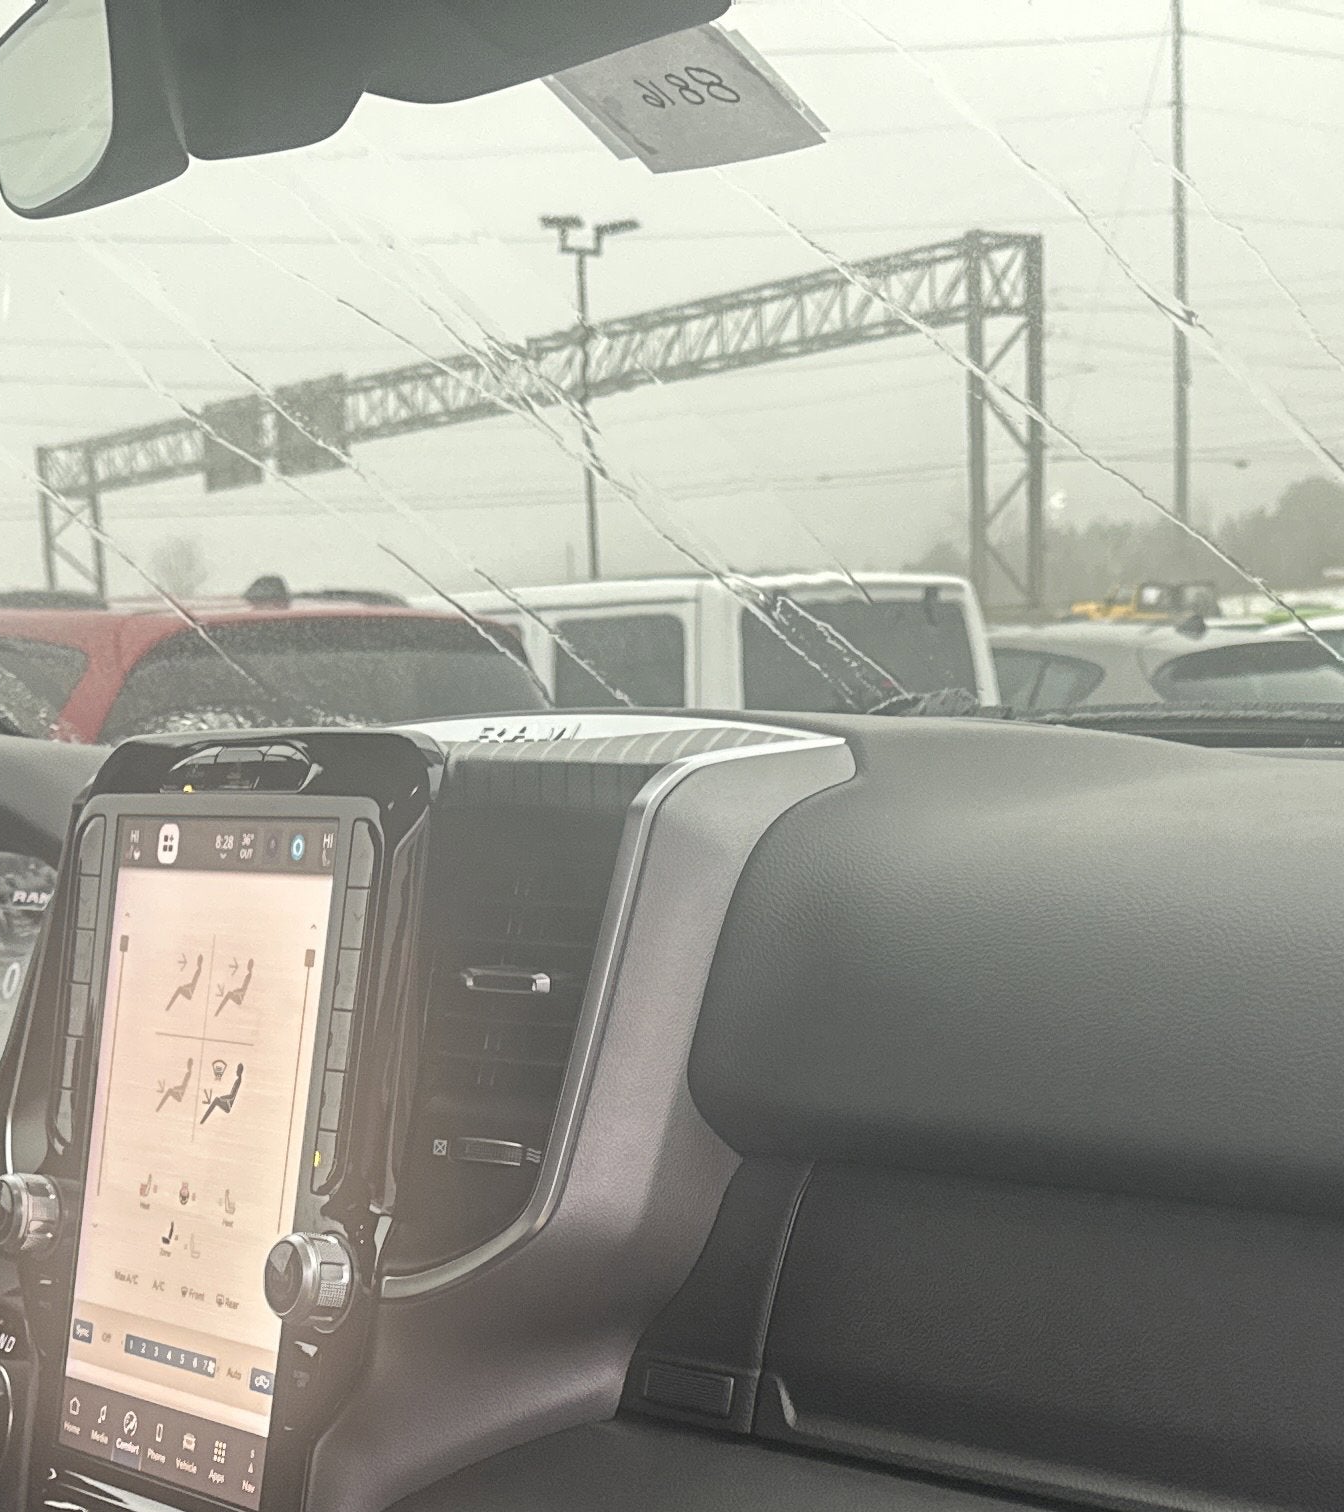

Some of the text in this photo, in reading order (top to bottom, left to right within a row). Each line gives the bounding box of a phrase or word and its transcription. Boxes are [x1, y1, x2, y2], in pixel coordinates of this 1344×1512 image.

[215, 834, 234, 850] 8:28
[323, 833, 334, 849] HI
[239, 848, 254, 860] OUT
